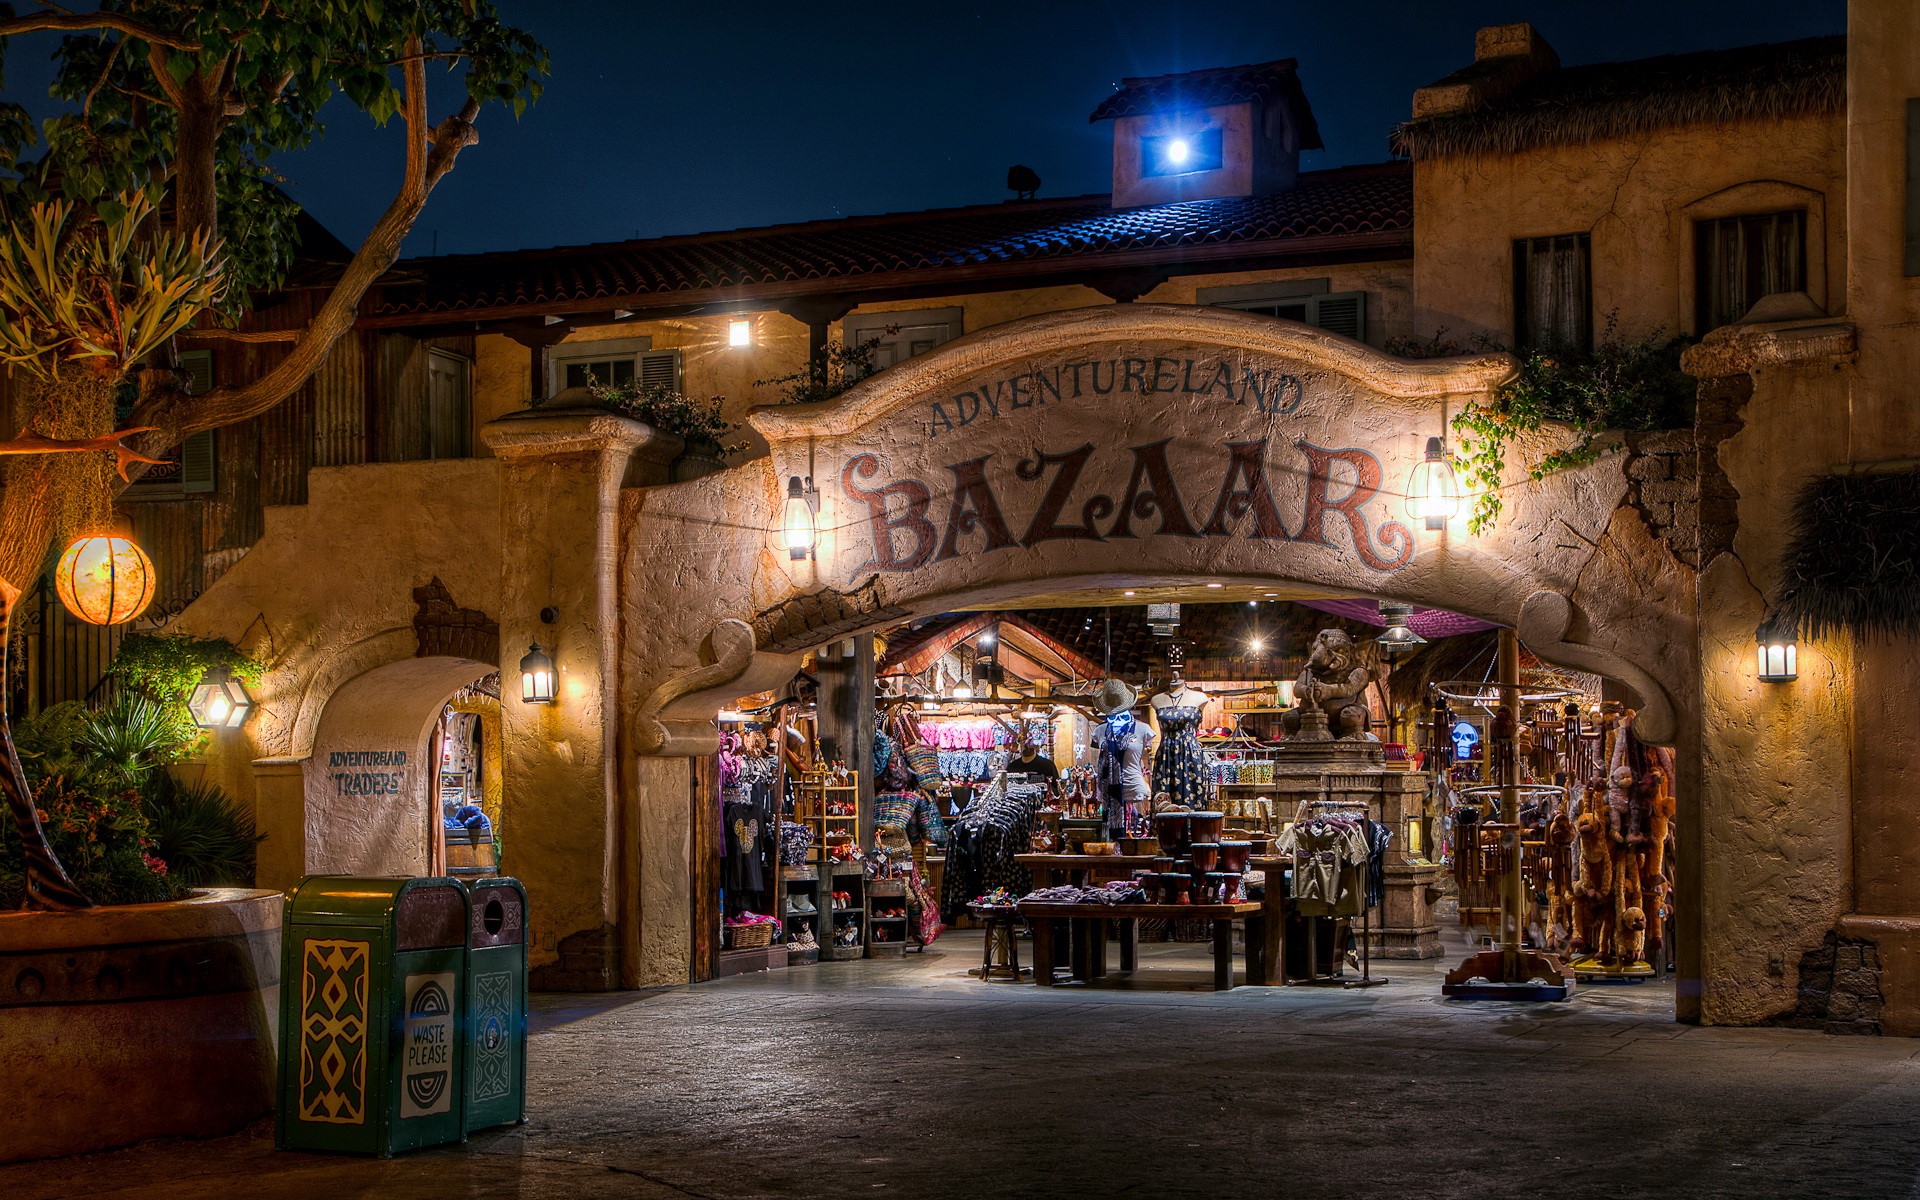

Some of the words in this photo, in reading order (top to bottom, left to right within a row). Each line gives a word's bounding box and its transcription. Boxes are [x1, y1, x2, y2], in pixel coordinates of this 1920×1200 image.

[930, 358, 1303, 439] ADVENTURELAND
[840, 437, 1415, 583] BAZAAR
[329, 751, 407, 767] ADVENTURELAND
[413, 1024, 445, 1045] WASTE
[408, 1044, 448, 1067] PLEASE
